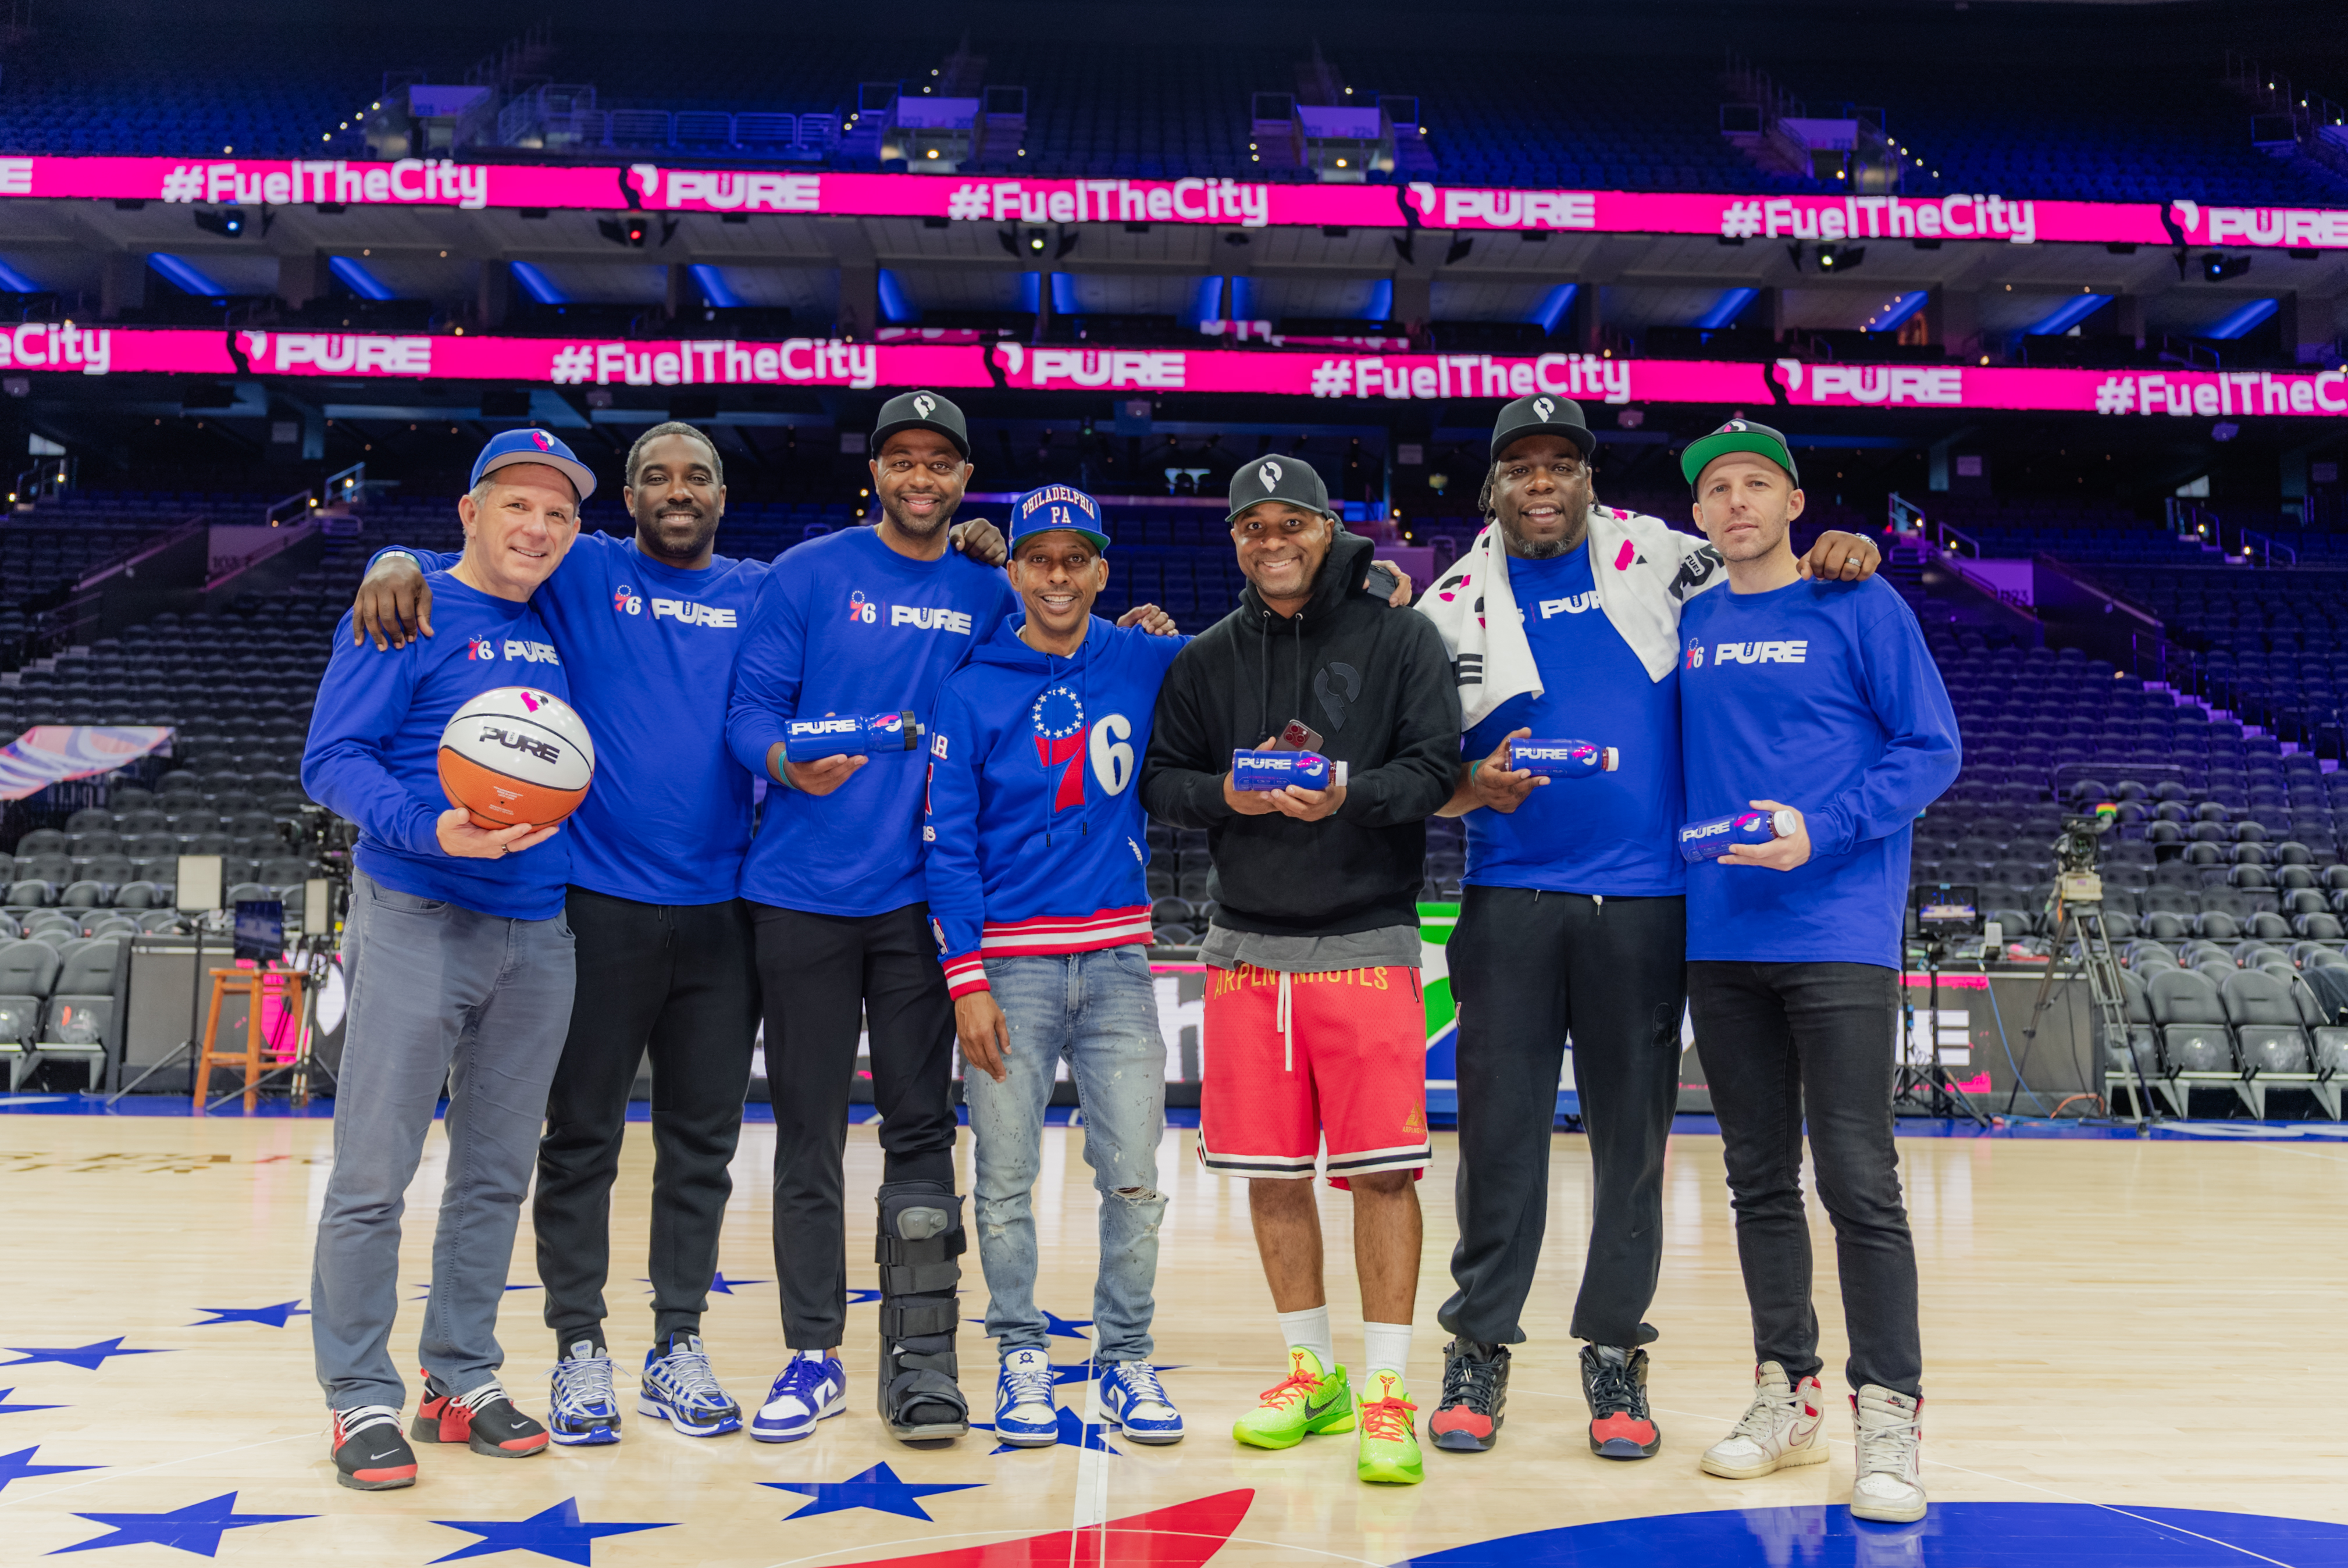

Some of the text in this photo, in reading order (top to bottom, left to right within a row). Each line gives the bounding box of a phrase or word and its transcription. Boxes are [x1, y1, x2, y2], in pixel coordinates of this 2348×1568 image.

[162, 159, 486, 209] #FuelTheCity
[667, 172, 820, 210] PURE
[949, 178, 1267, 227] #FuelTheCity
[1445, 191, 1595, 227] PURE
[1722, 194, 2035, 243] #FuelTheCity
[2209, 208, 2348, 246] PURE
[276, 334, 432, 373] PURE
[551, 338, 876, 389] #FuelTheCity
[1032, 350, 1185, 387] PURE
[1312, 353, 1630, 404] #FuelTheCity
[1812, 366, 1961, 403] PURE
[1022, 487, 1095, 519] PHILADELPHIA
[1051, 507, 1071, 523] PA
[1685, 554, 1701, 575] FUEL
[615, 593, 737, 628] 76 PURE
[850, 600, 972, 635] 76 PURE
[1539, 590, 1601, 619] PU
[468, 640, 494, 661] 76
[504, 639, 560, 666] PURE
[1687, 640, 1808, 669] 76 PURE
[479, 726, 560, 764] PURE
[792, 719, 856, 735] PURE
[1034, 713, 1134, 814] 76
[1238, 757, 1291, 769] PURE
[1515, 747, 1567, 760] PURE
[1683, 821, 1730, 842] PURE
